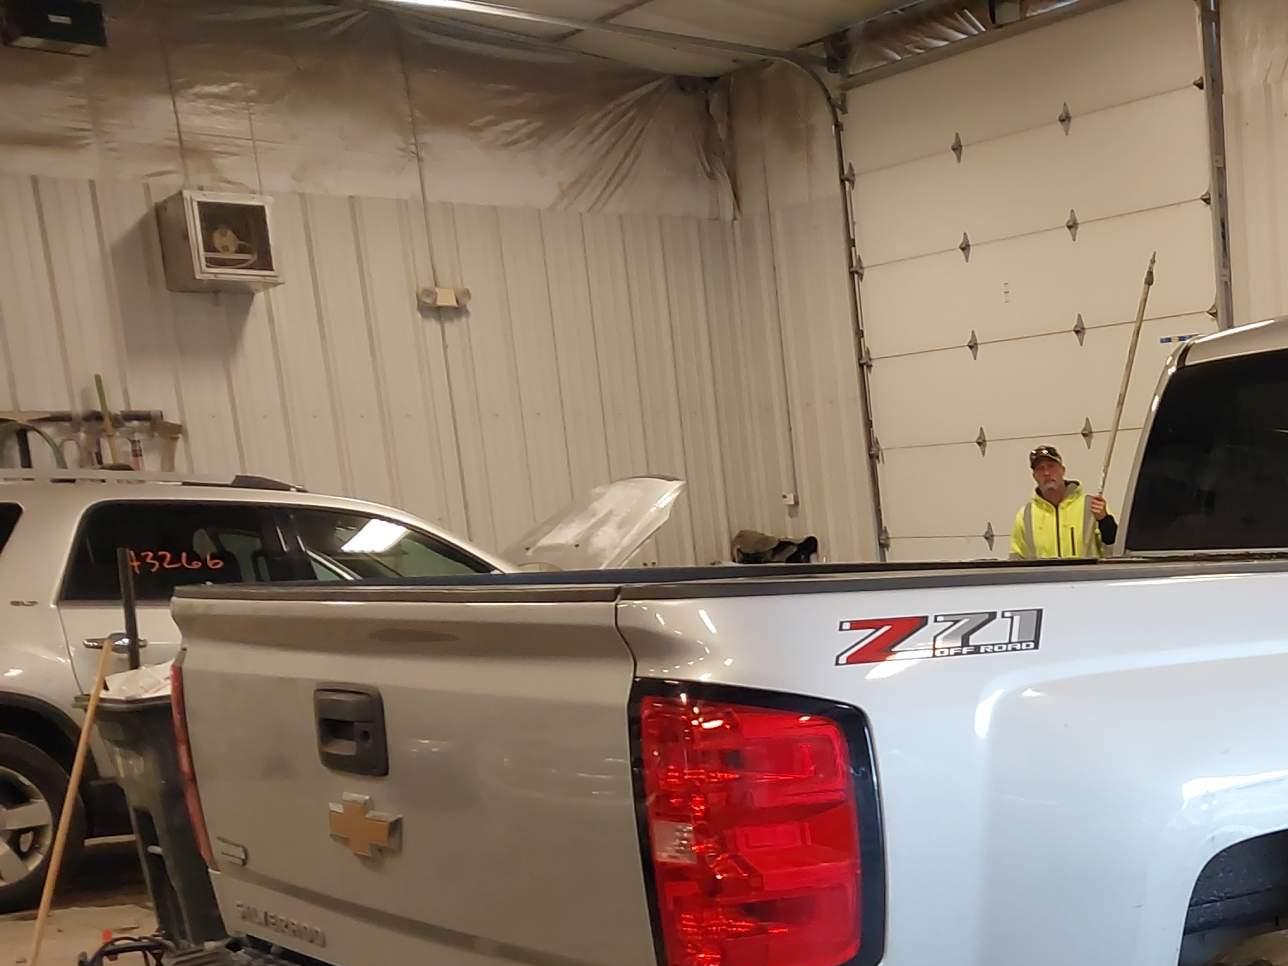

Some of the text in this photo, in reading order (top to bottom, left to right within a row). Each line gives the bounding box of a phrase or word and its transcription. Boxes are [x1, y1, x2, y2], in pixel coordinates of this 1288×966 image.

[835, 608, 1043, 666] Z71
[934, 641, 1035, 657] OFF ROAD
